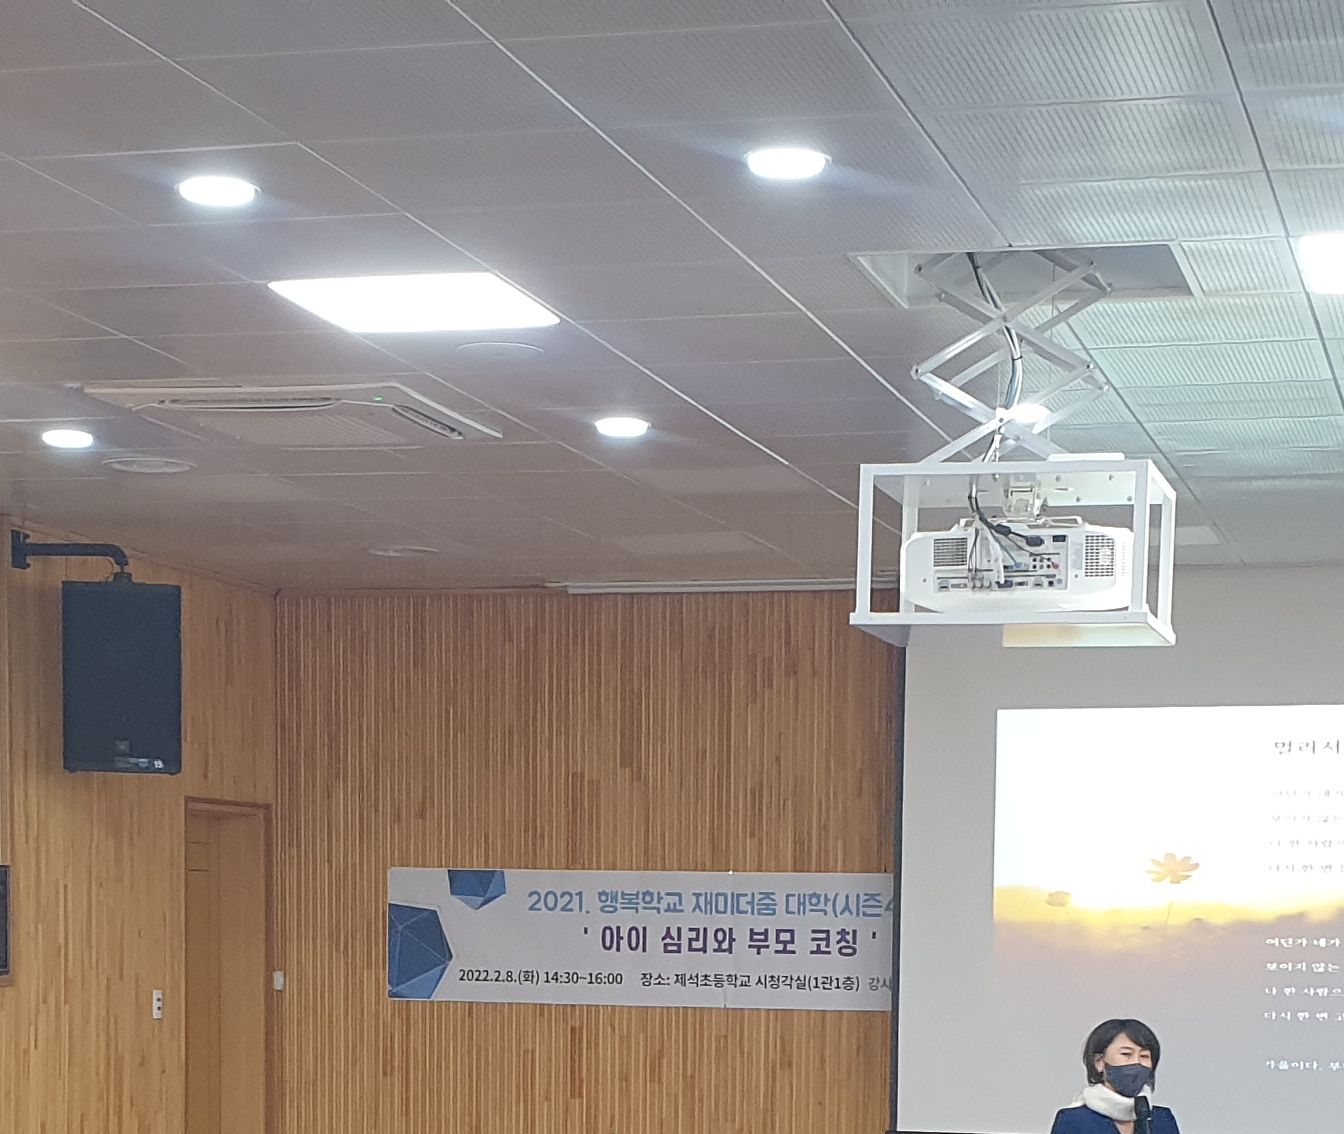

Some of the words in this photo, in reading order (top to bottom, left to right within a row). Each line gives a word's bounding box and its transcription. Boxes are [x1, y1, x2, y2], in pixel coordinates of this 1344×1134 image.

[527, 890, 590, 914] 2021.
[597, 889, 685, 914] 행복학교
[691, 891, 778, 917] 재미더줌
[601, 925, 647, 952] 아이
[661, 926, 737, 955] 심리와
[747, 927, 797, 956] 부모
[809, 928, 858, 957] 코칭
[458, 968, 541, 986] 2022.2.8.(화)
[544, 970, 624, 985] 14:30~16:00
[640, 972, 671, 987] 장소:
[674, 972, 751, 988] 제석초등학교
[755, 973, 860, 992] 시청각실(1관1층)
